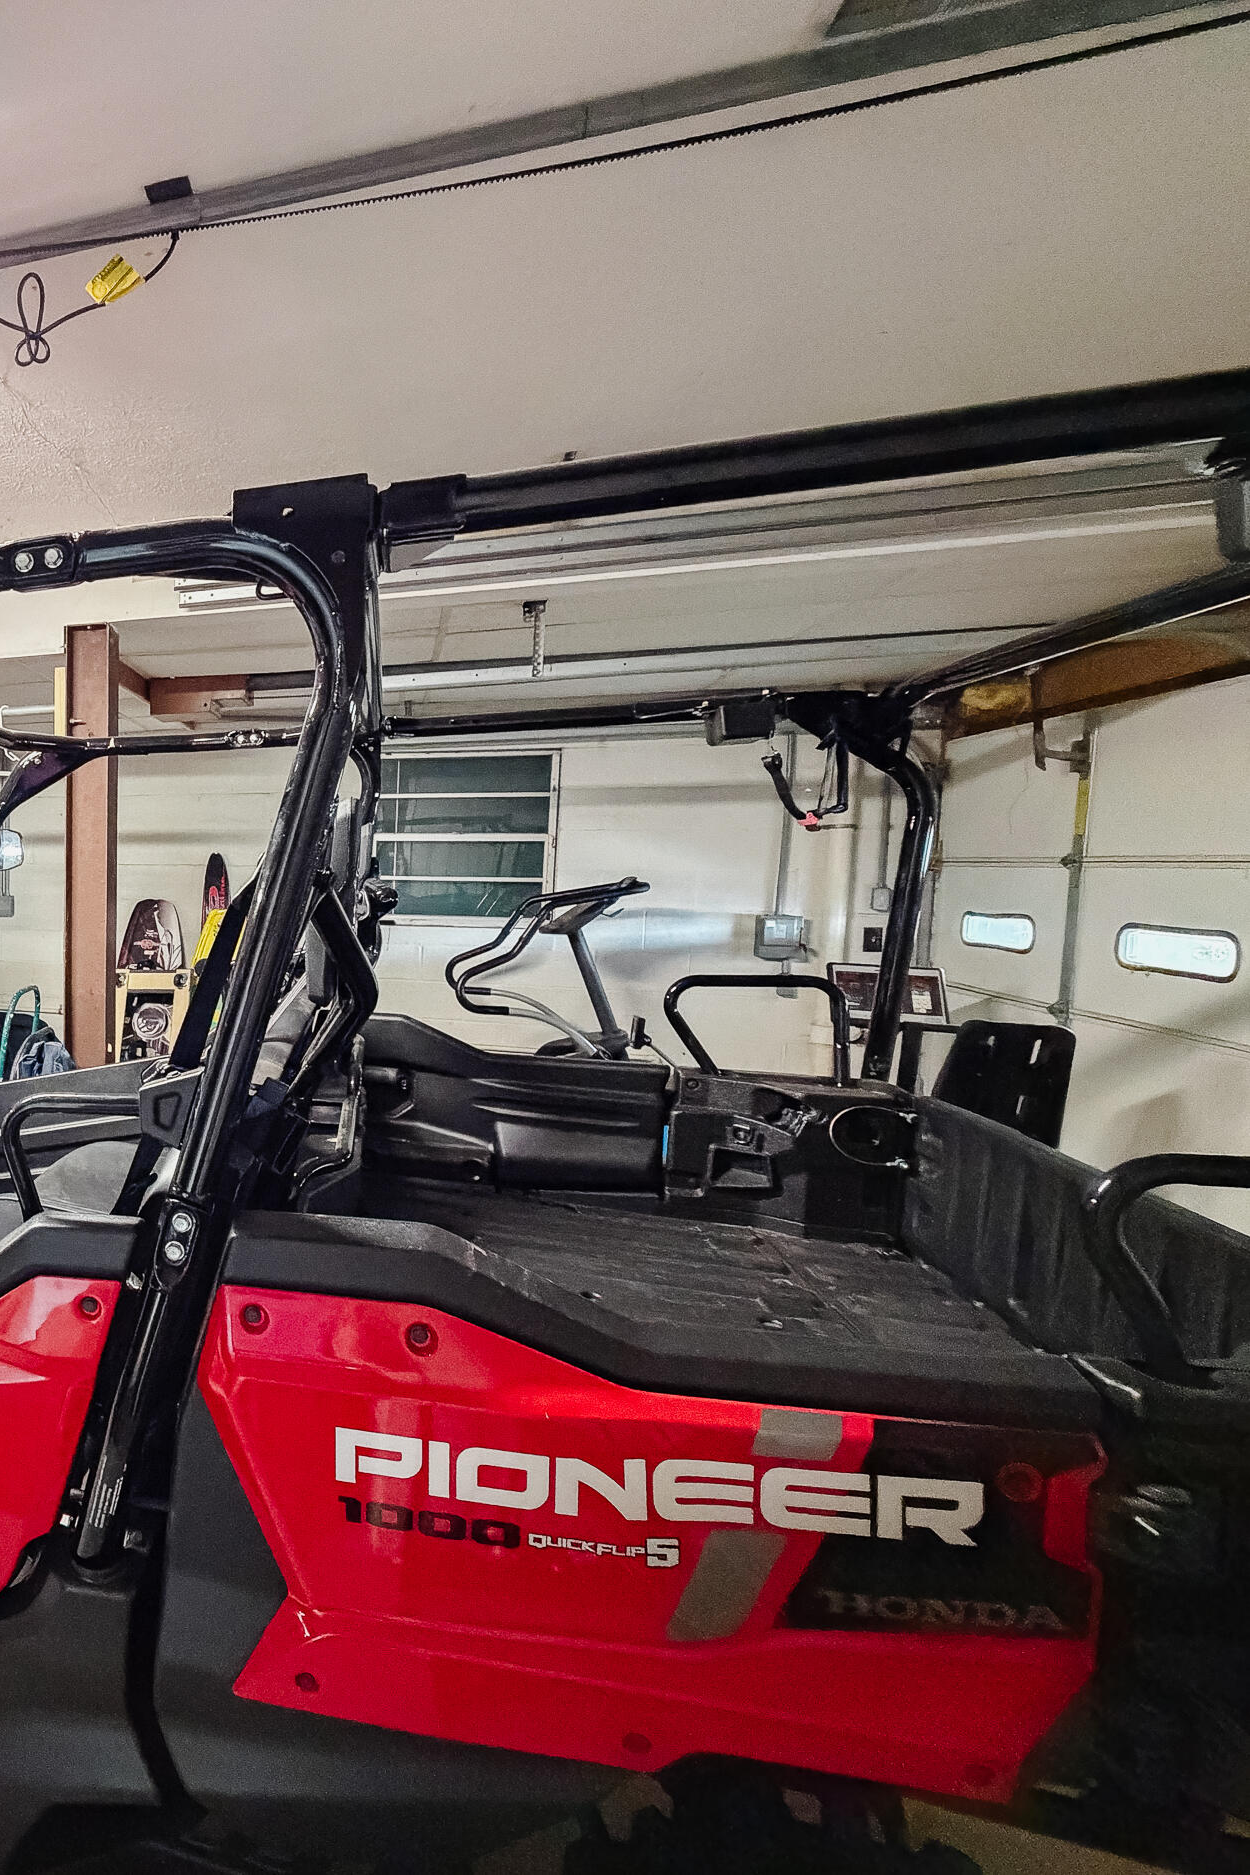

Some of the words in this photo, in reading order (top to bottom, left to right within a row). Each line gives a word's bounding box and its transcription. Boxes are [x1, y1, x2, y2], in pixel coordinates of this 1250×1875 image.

[335, 1426, 985, 1547] PIONEER
[338, 1495, 521, 1548] 1000
[818, 1588, 1064, 1630] HONDA
